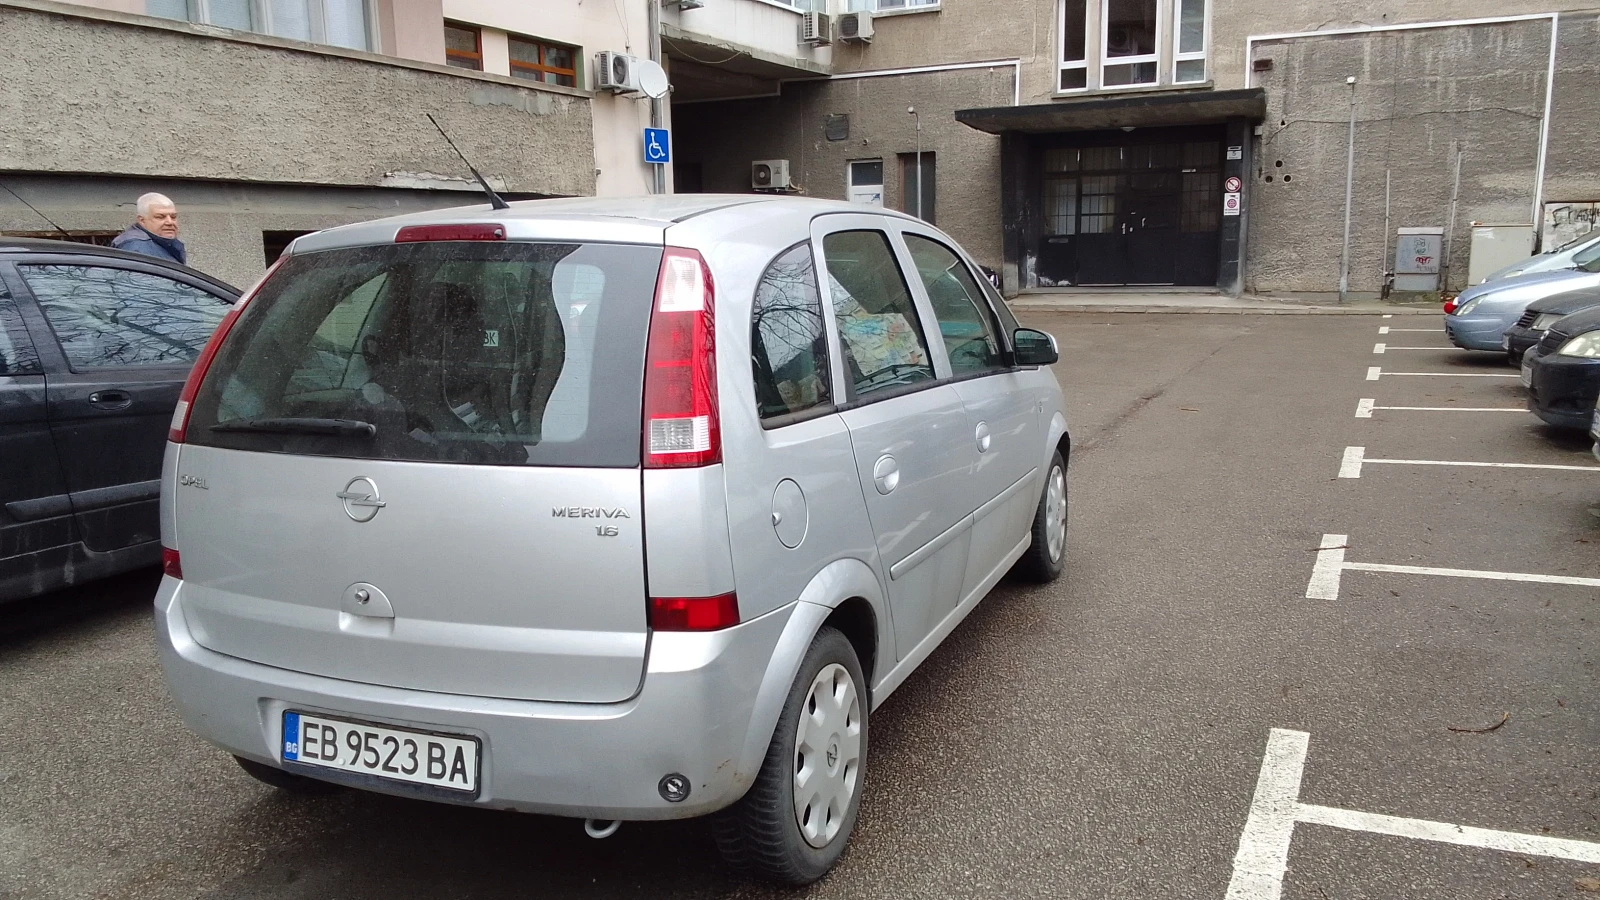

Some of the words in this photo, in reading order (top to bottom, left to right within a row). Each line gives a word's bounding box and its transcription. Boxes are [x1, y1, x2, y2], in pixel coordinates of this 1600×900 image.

[180, 474, 209, 490] OPEL
[552, 507, 631, 519] MERIVA
[286, 741, 298, 754] BG
[302, 721, 339, 762] EB
[346, 730, 419, 776] 9523
[426, 741, 469, 785] BA
